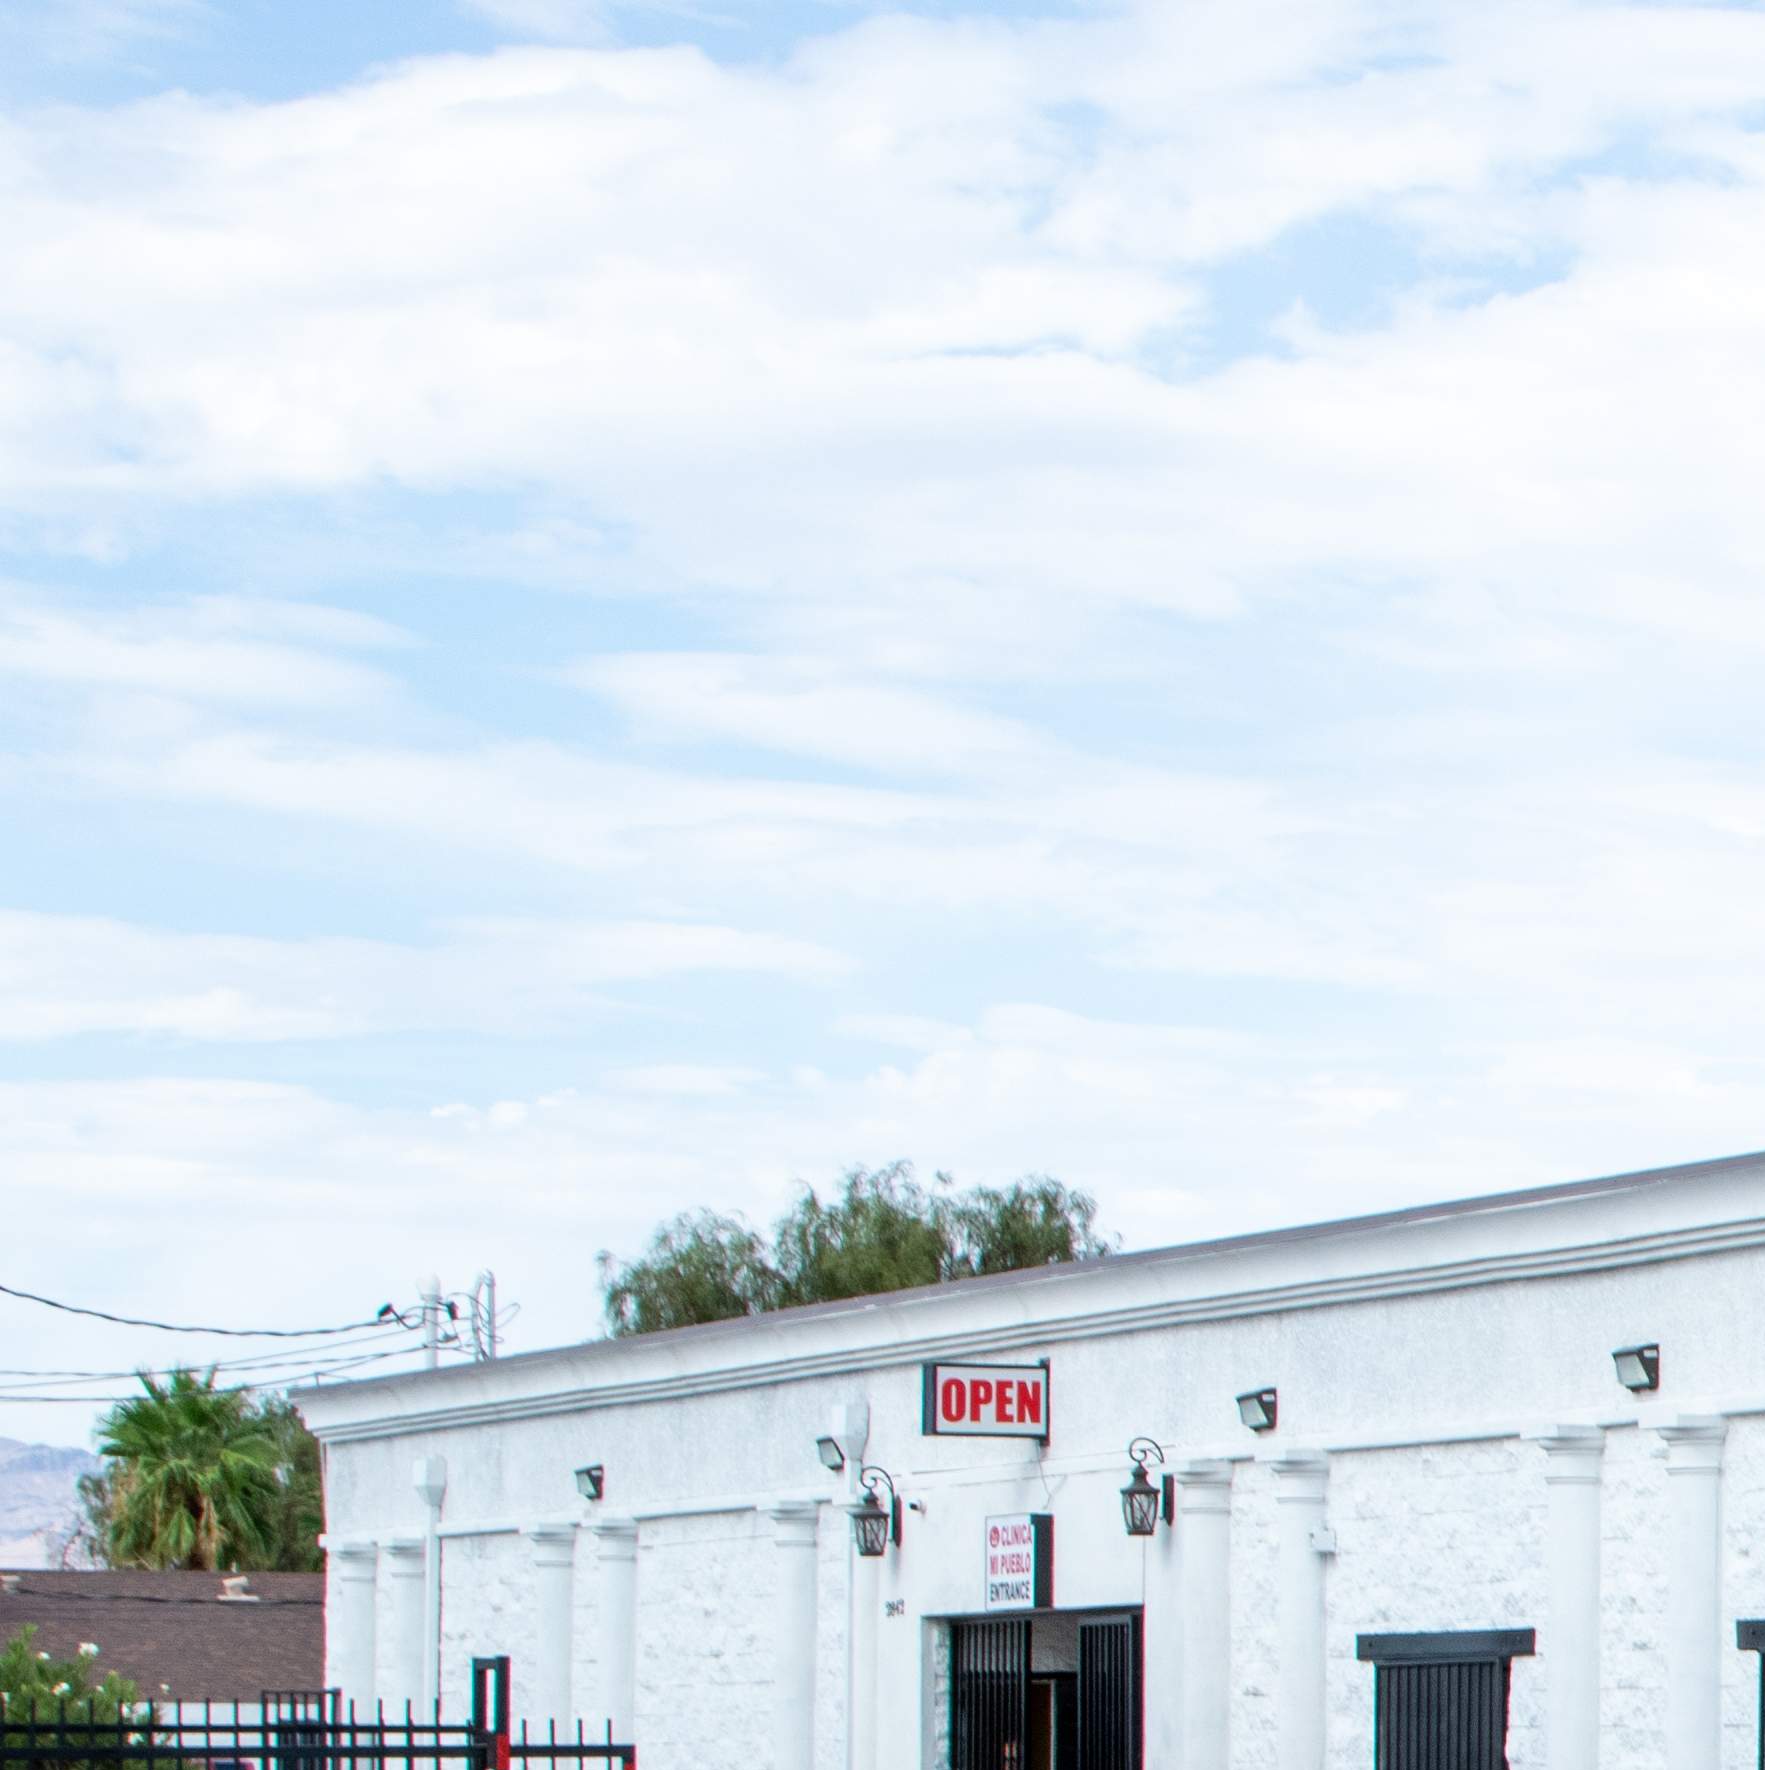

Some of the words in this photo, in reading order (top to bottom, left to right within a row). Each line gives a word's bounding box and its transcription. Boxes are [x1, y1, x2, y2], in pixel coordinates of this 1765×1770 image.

[941, 1377, 1041, 1424] OPEN
[1001, 1524, 1032, 1547] CLINICA
[989, 1552, 999, 1576] MI
[1001, 1551, 1031, 1575] PUEBLO
[989, 1580, 1030, 1603] ENTRANCE
